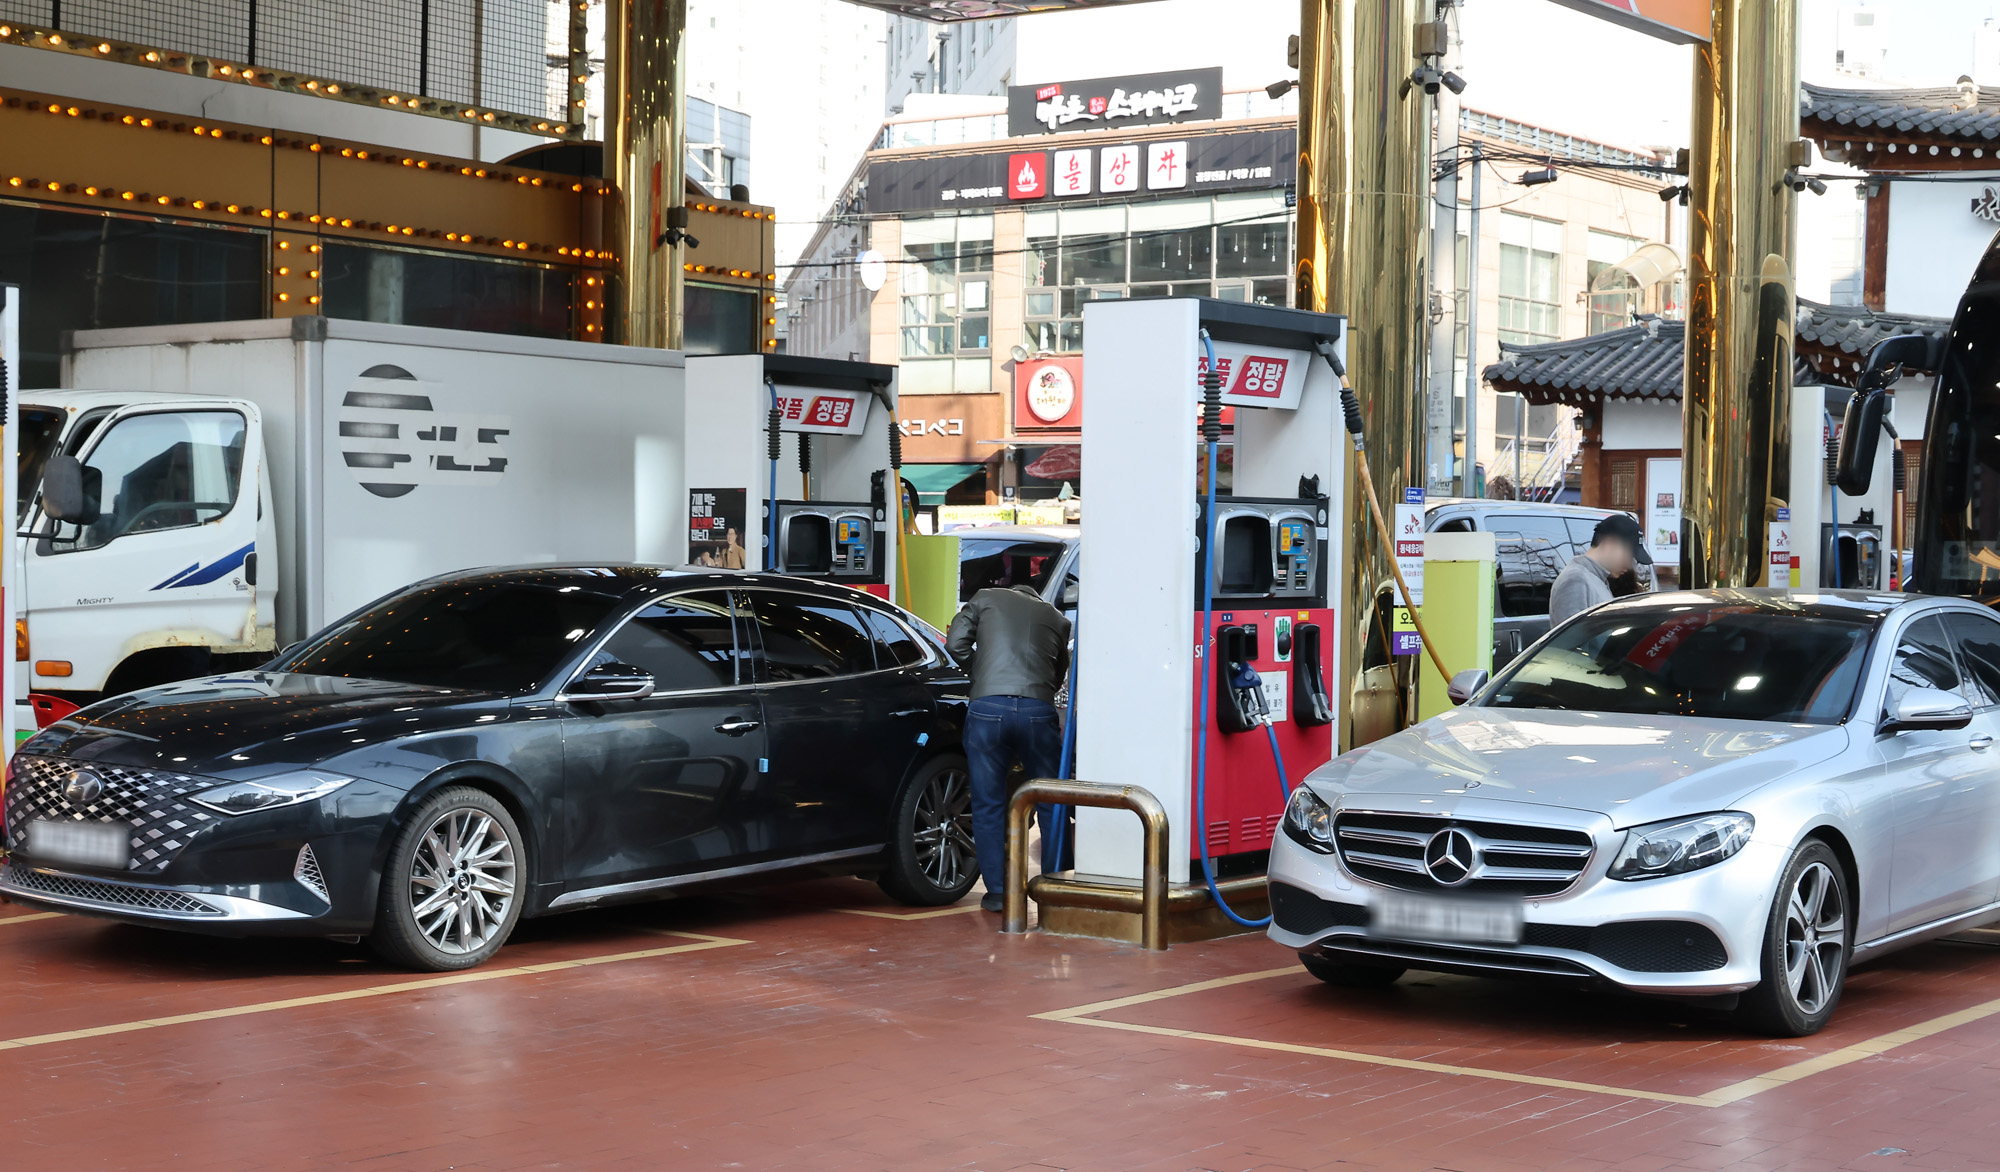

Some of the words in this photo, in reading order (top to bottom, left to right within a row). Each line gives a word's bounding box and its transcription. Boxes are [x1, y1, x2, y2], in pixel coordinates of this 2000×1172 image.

[1245, 361, 1284, 392] 정량
[816, 400, 851, 423] 정량
[1404, 524, 1414, 534] SK
[76, 597, 114, 605] MIGHTY
